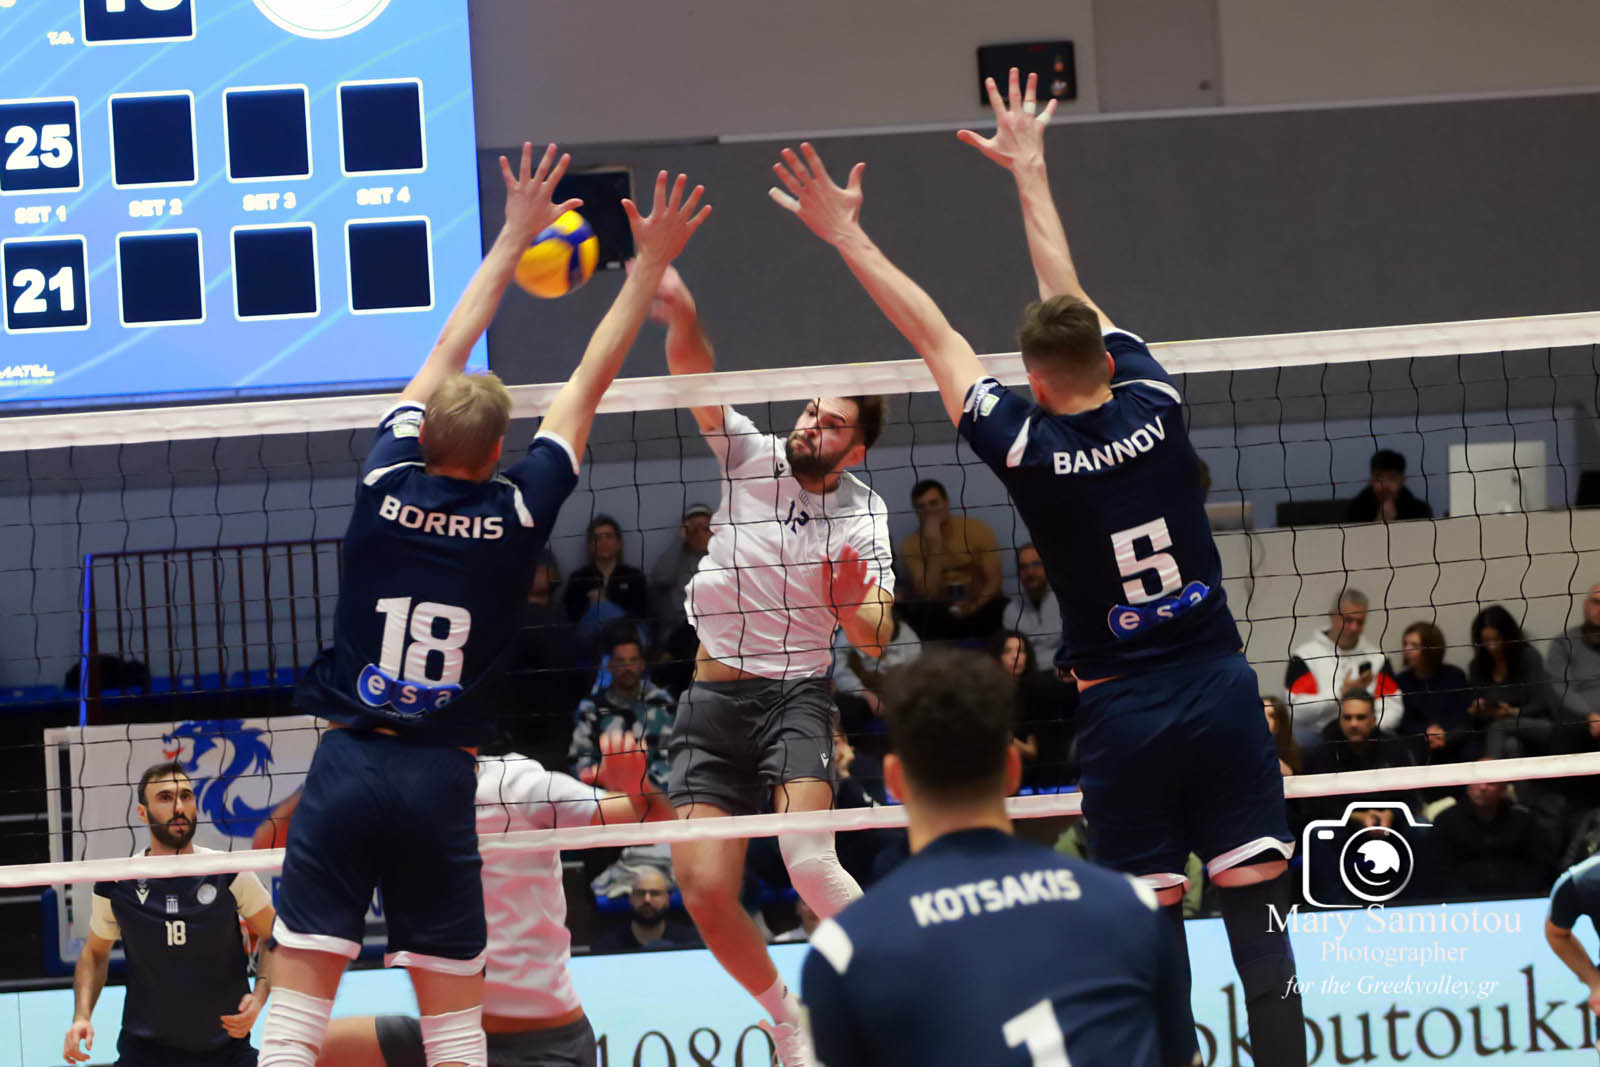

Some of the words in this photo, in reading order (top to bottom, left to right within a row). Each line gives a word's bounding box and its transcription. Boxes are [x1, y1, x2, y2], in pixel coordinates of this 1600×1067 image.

[4, 124, 74, 170] 25
[14, 206, 52, 224] SET
[55, 205, 67, 222] 1
[129, 199, 166, 217] SET
[169, 198, 183, 215] 2
[242, 193, 280, 211] SET
[283, 192, 297, 209] 3
[356, 187, 394, 205] SET
[397, 186, 411, 203] 4
[12, 266, 75, 314] 21
[1053, 415, 1166, 475] BANNOV
[378, 494, 504, 540] BORRIS
[1110, 517, 1183, 605] 5
[376, 597, 471, 688] 18
[909, 869, 1082, 927] KOTSAKIS
[165, 920, 187, 946] 18
[1002, 998, 1071, 1067] 1
